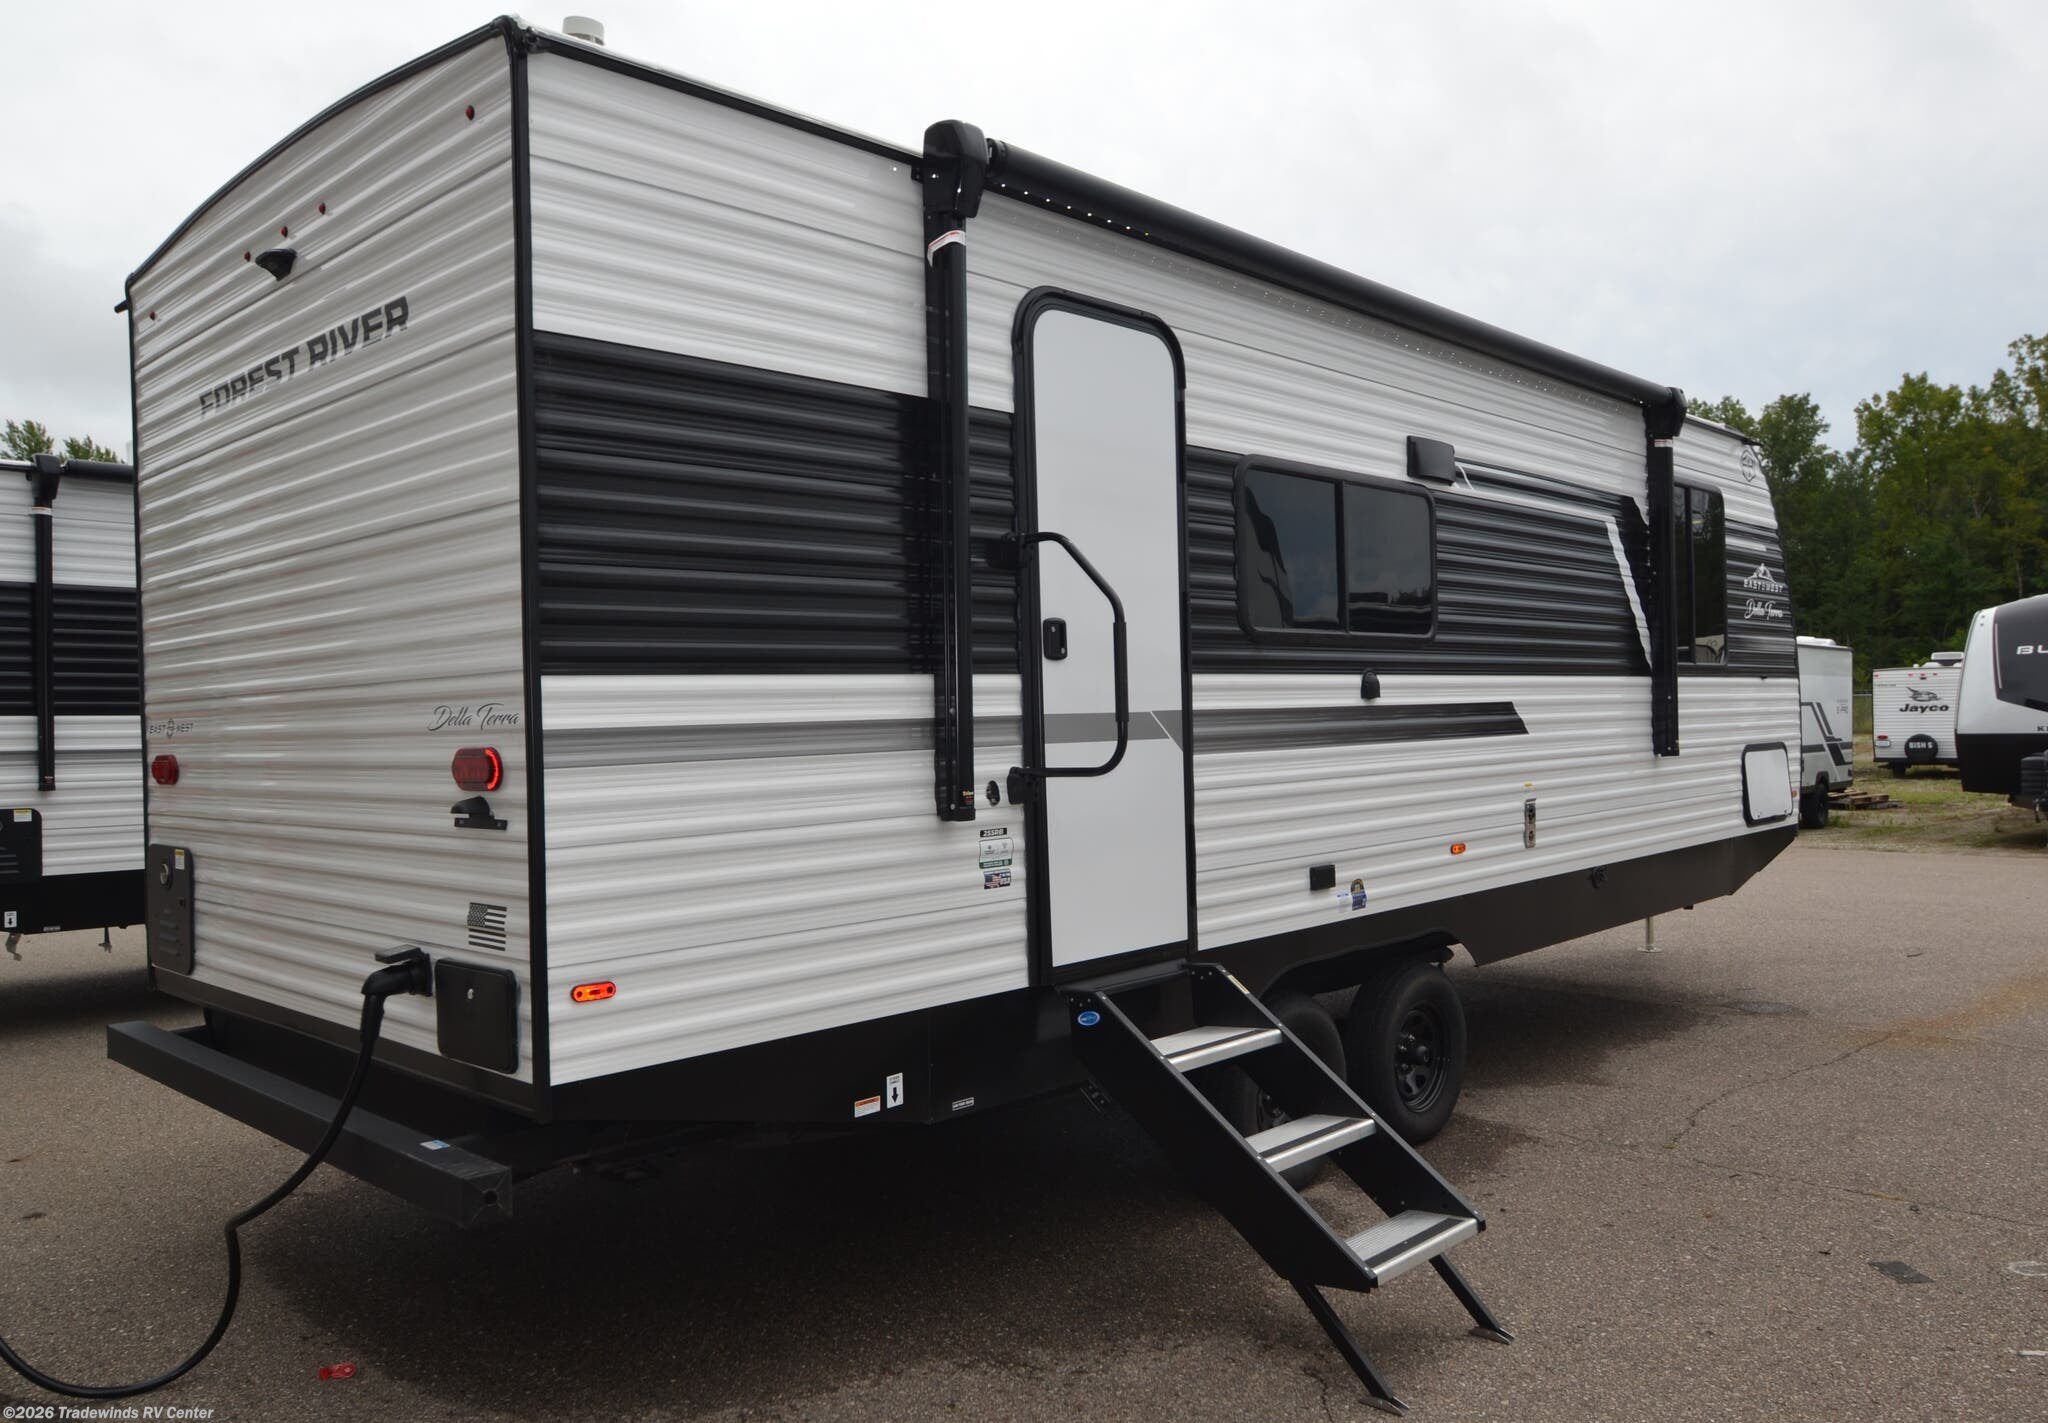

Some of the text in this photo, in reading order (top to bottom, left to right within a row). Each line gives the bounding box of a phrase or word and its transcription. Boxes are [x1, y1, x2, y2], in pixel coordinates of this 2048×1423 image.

[200, 296, 409, 416] FOREST RIVER
[427, 702, 520, 732] Della Terra
[1899, 704, 1949, 713] Jayco
